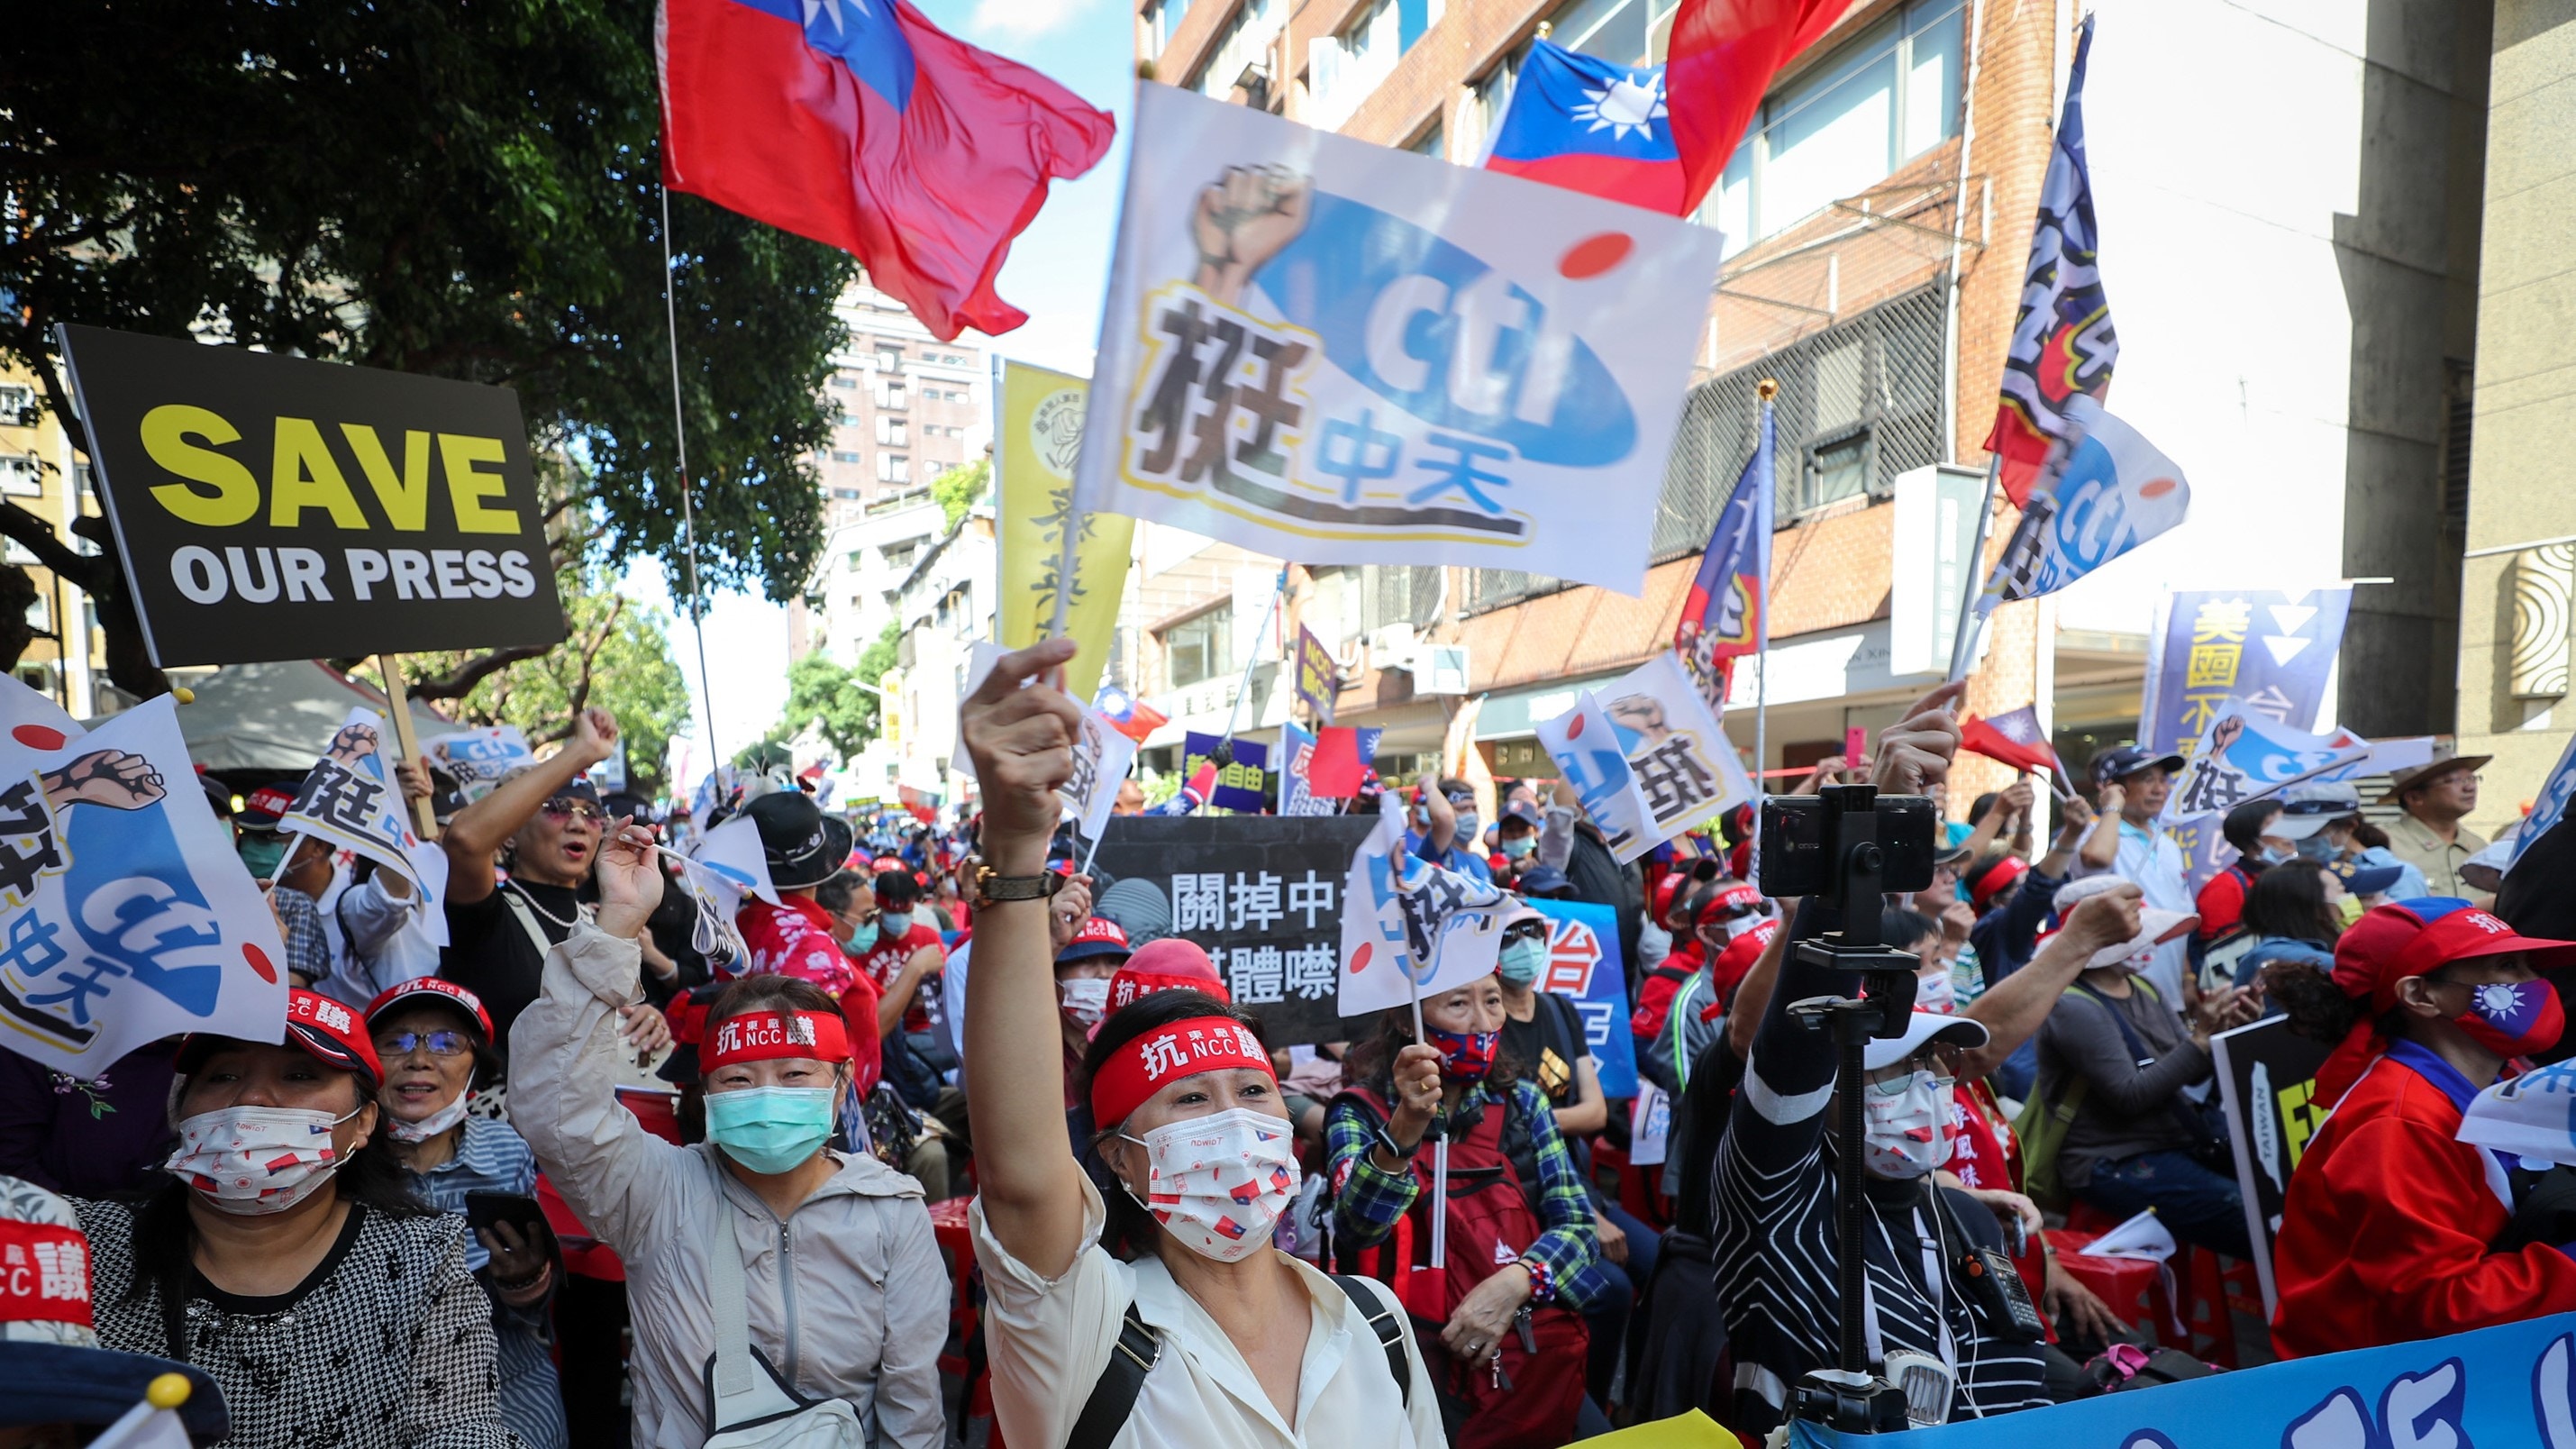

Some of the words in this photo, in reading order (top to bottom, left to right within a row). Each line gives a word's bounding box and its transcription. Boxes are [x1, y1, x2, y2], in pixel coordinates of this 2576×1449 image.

[140, 404, 522, 534] SAVE
[170, 544, 333, 605] OUR
[343, 547, 536, 601] PRESS
[1306, 639, 1332, 680] NCC
[1172, 870, 1352, 934] 關掉中
[716, 1021, 742, 1056] 抗
[746, 1030, 781, 1046] NCC
[1140, 1034, 1189, 1081] 抗
[1192, 1038, 1236, 1059] NCC
[2255, 1087, 2271, 1159] TAIWAN
